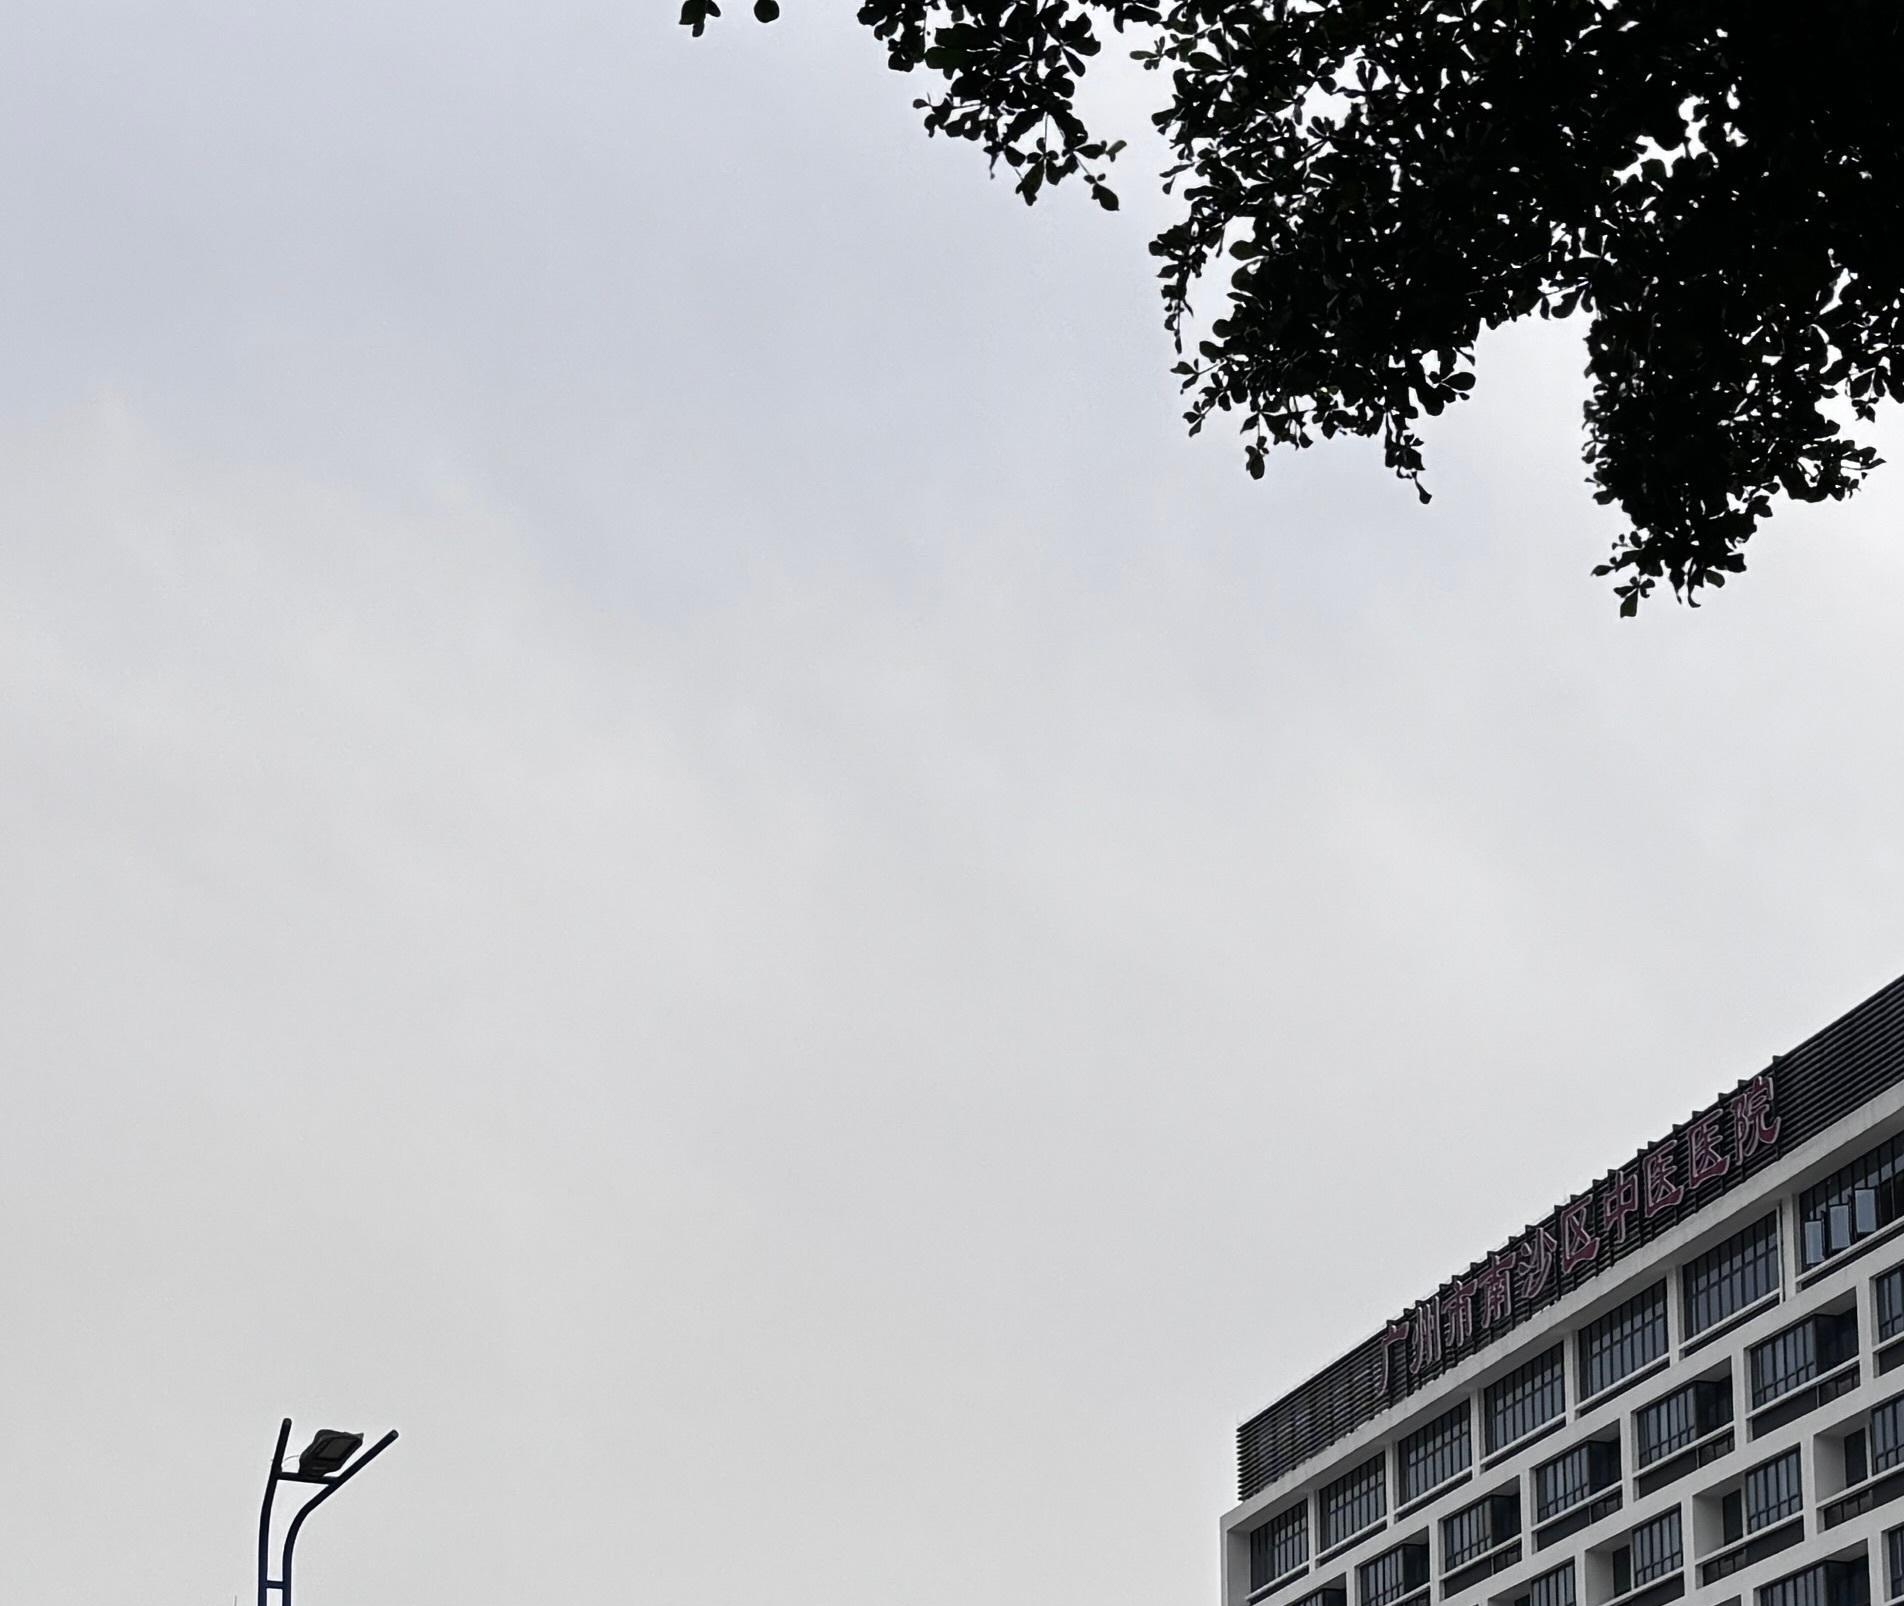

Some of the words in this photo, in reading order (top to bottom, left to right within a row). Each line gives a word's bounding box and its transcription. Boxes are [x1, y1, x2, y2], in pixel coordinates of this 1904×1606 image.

[1378, 1075, 1782, 1396] 广州市南沙区中医医院
